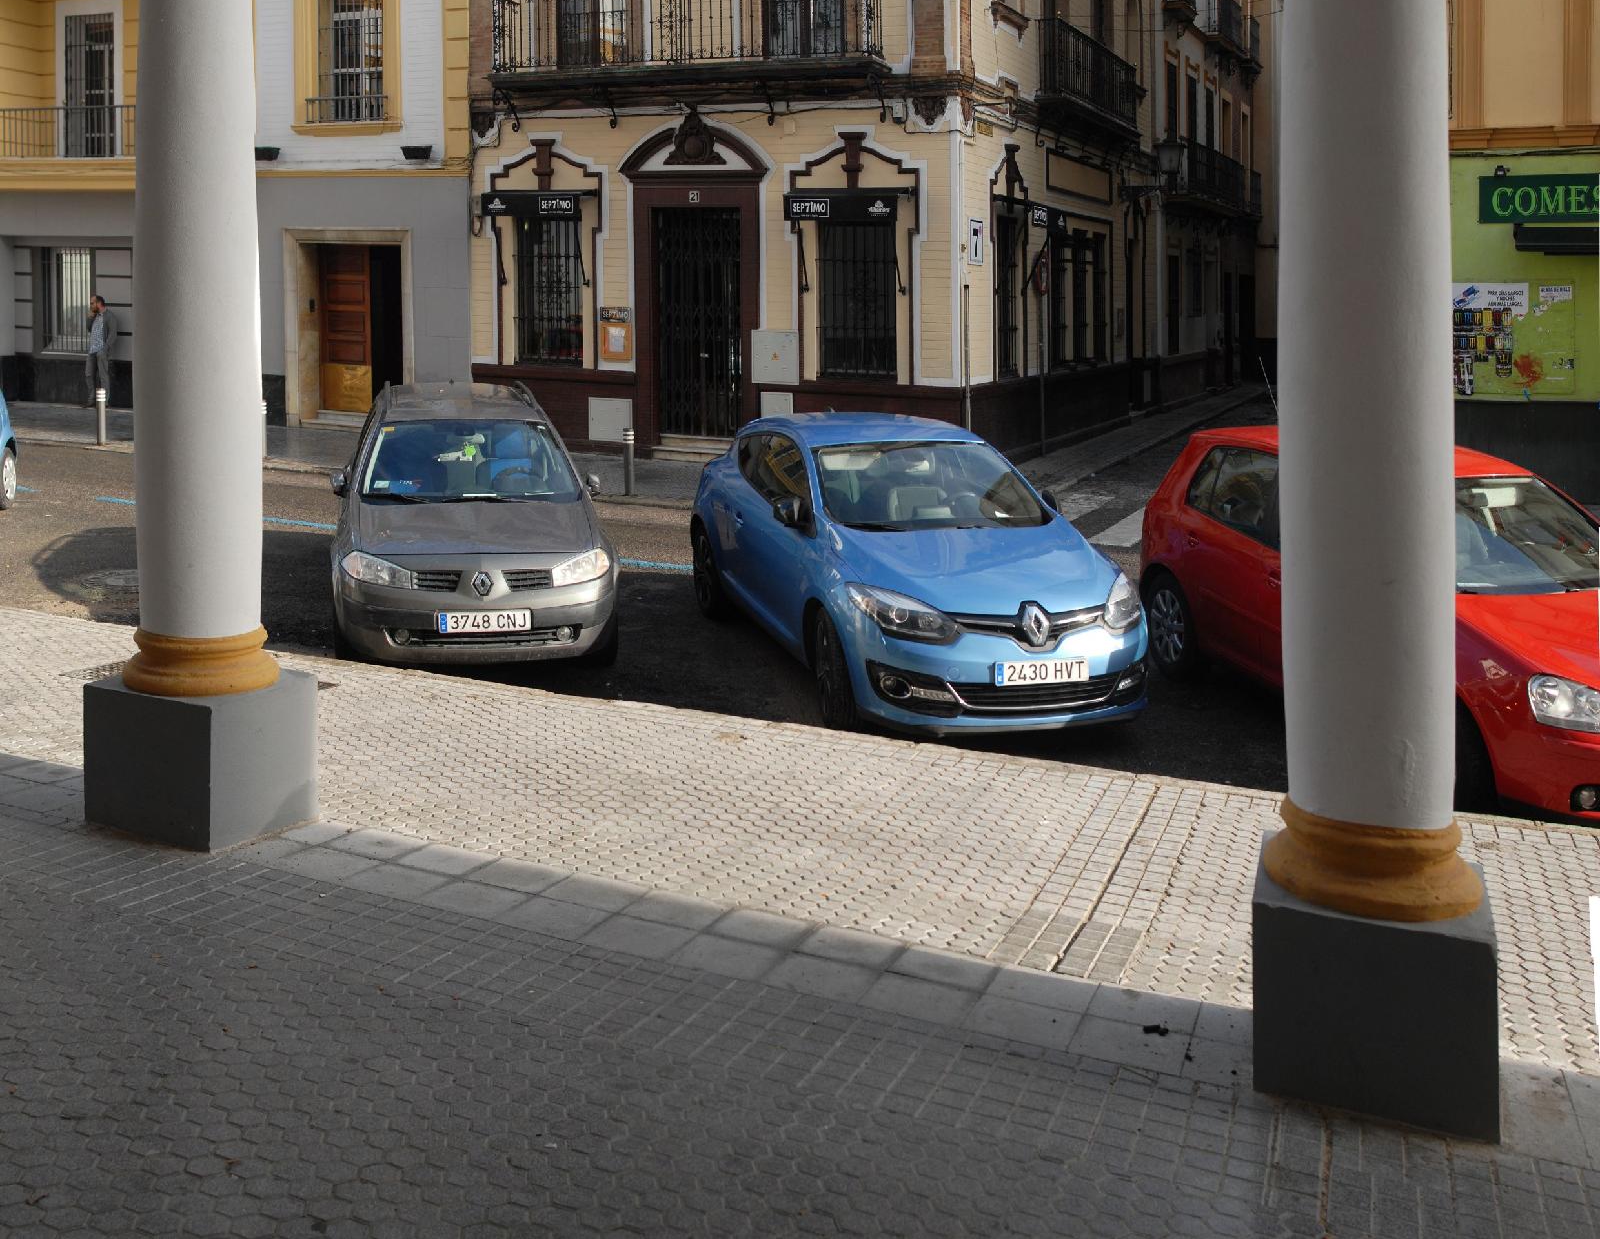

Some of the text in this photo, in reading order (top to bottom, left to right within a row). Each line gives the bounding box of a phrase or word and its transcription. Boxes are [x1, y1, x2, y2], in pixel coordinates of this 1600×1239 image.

[690, 192, 699, 202] 21
[450, 613, 527, 630] 3748 CNJ
[1007, 660, 1085, 682] 2430 HVT
